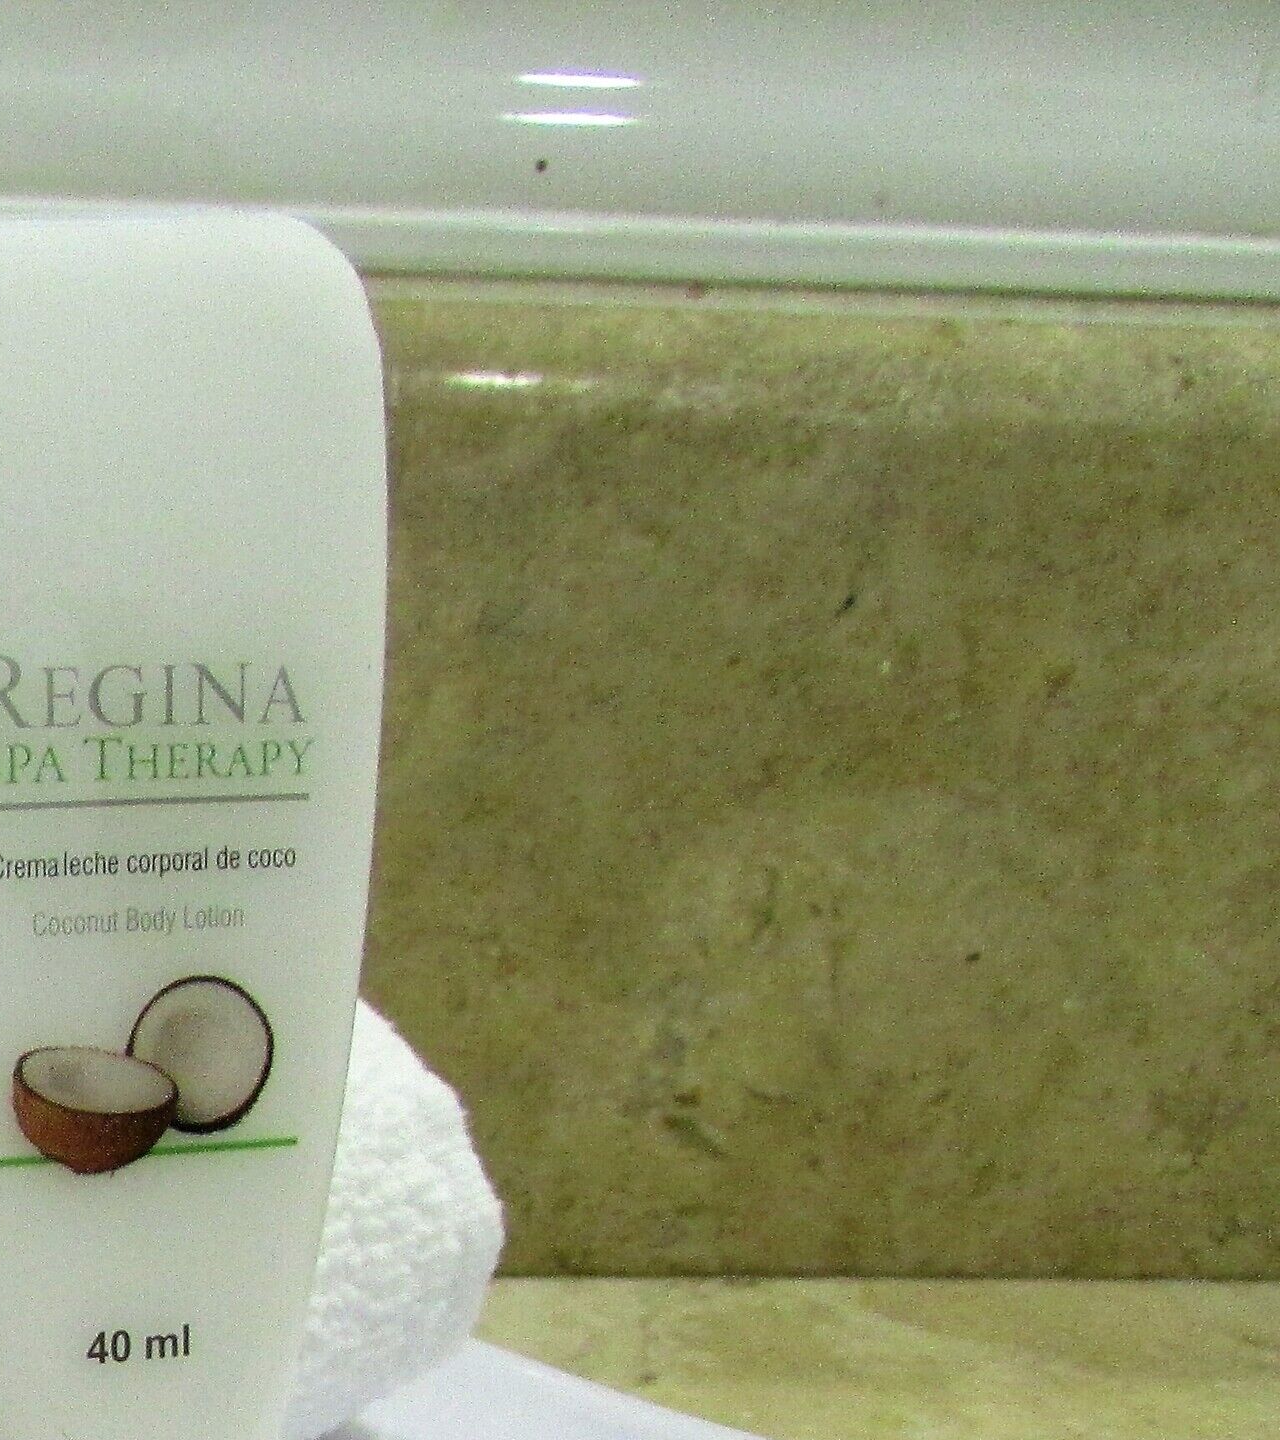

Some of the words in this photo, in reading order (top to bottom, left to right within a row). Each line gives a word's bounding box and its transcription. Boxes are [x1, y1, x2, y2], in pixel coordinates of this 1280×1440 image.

[83, 736, 314, 782] THERAPY
[126, 847, 209, 878] corporal
[216, 845, 241, 870] de
[248, 847, 297, 869] coco
[33, 910, 120, 938] Coconut
[126, 905, 177, 936] Body
[183, 904, 246, 930] Lotion
[86, 1329, 131, 1364] 40
[145, 1323, 190, 1360] ml
